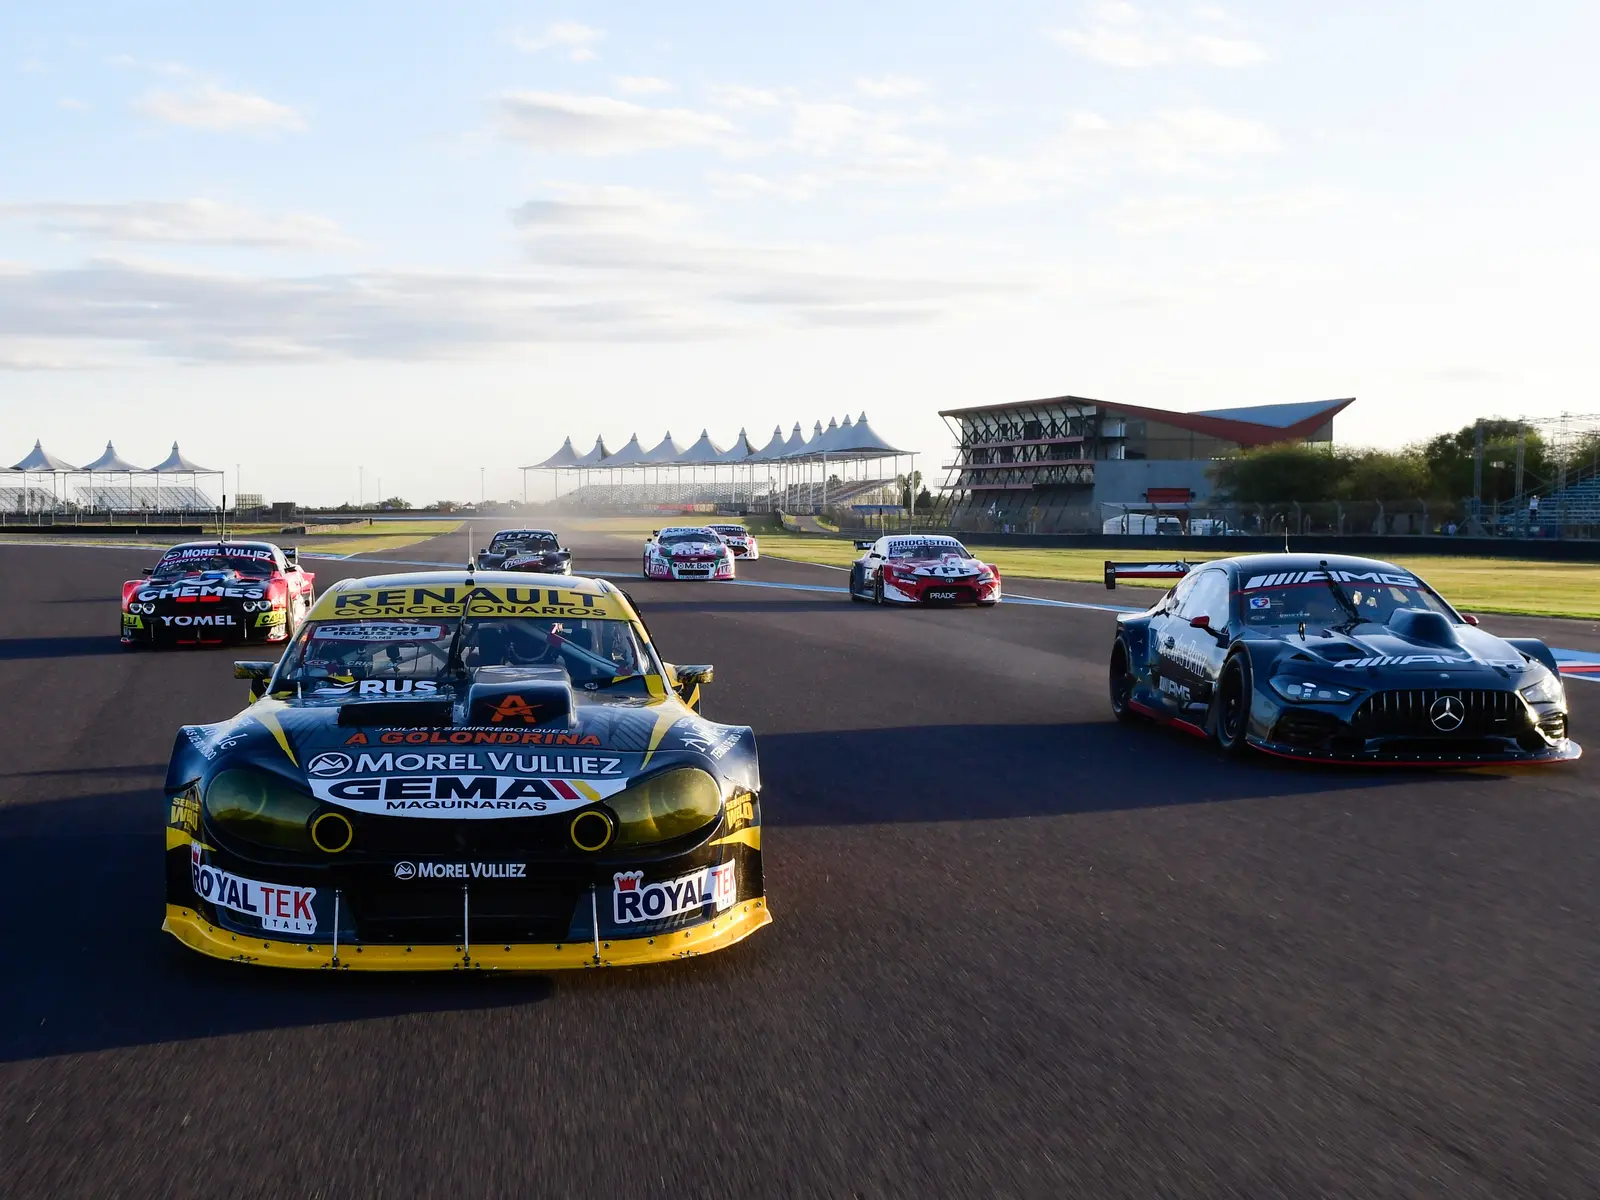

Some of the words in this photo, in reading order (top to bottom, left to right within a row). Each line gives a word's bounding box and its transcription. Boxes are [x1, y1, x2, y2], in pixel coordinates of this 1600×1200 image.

[495, 533, 554, 541] ELPRA
[182, 548, 222, 558] MOREL
[225, 548, 272, 560] VULLIEZ
[923, 567, 971, 575] YPF
[138, 586, 264, 601] CHEMES
[334, 587, 605, 609] RENAULT
[334, 603, 607, 617] CONCESONARIOS
[161, 615, 237, 627] YOMEL
[359, 680, 437, 694] RUS
[443, 726, 569, 735] SEMIRREMOLQUES
[345, 733, 370, 745] A
[380, 733, 601, 746] GOLONDRINA
[355, 753, 484, 773] MOREL
[484, 753, 623, 775] VULLIEZ
[327, 777, 555, 801] GEMA
[386, 800, 548, 811] MAQUINARIAS
[418, 863, 470, 878] MOREL
[470, 862, 526, 878] VULLIEZ
[263, 919, 314, 931] ITALY
